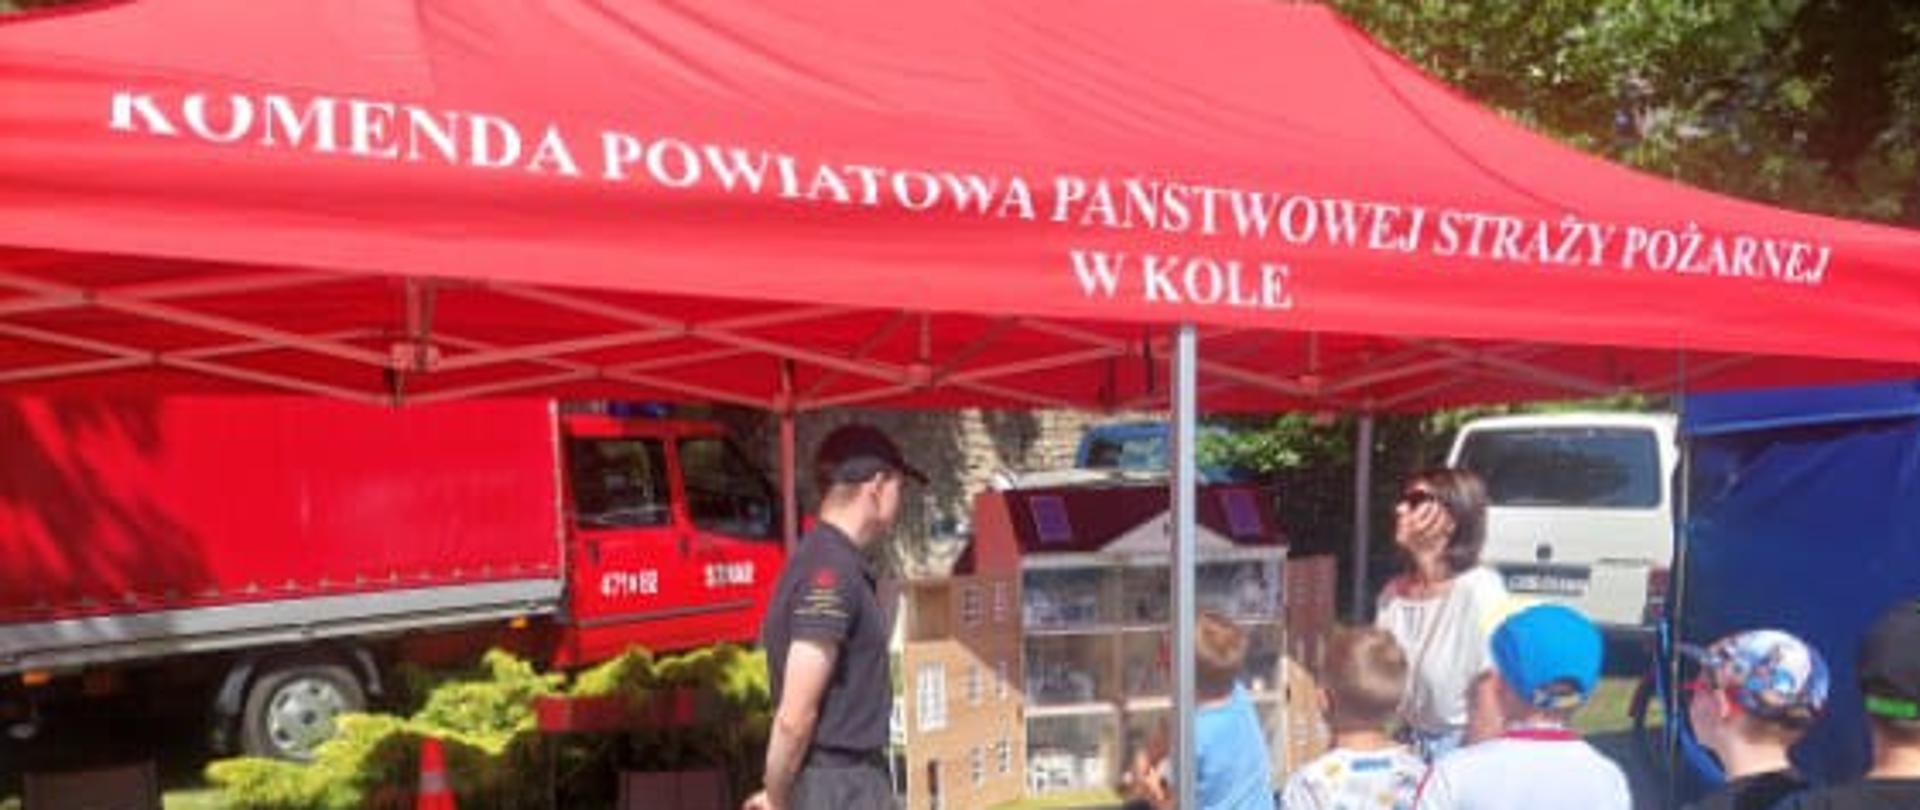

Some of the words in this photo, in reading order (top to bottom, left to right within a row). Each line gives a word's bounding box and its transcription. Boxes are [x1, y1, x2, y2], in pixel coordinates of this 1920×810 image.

[108, 91, 580, 177] KOMENDA
[601, 131, 1036, 219] POWIATOWA
[1433, 209, 1615, 268] STRAŻY
[1621, 221, 1831, 284] POŻARNEJ
[1069, 249, 1124, 297] W
[1142, 254, 1294, 310] KOLE
